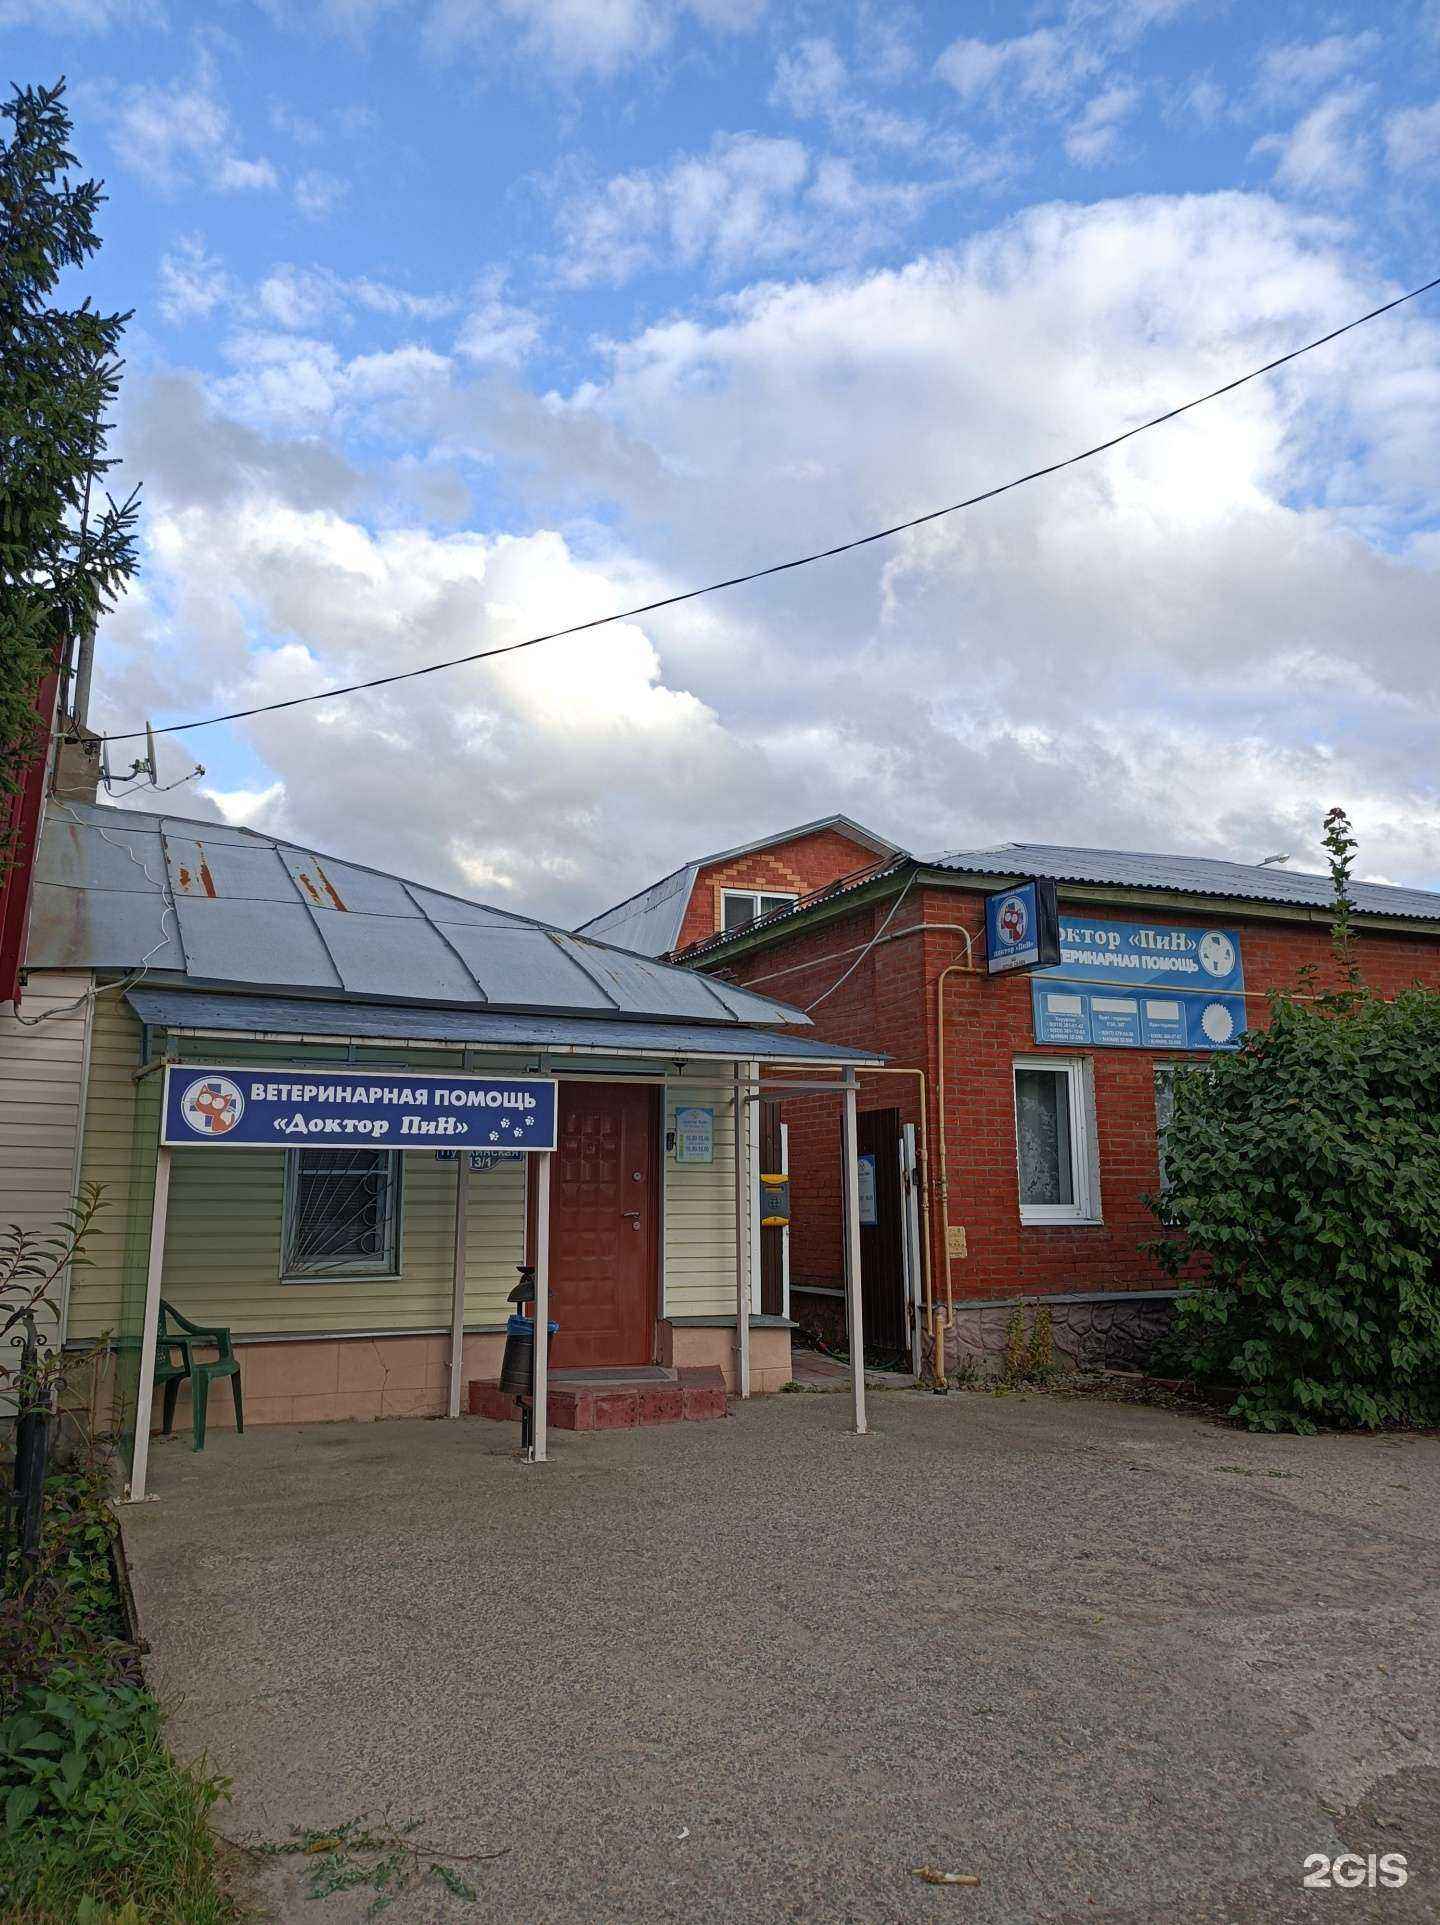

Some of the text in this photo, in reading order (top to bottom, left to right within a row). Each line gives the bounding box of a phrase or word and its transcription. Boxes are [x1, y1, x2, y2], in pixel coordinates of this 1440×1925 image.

[1059, 928, 1197, 951] октор «ПиН»
[1060, 949, 1200, 974] ЕРИНАРНАЯ ПОМОЩЬ
[250, 1083, 537, 1111] ВЕТЕРИНАРНАЯ ПОМОЩЬ
[273, 1113, 470, 1138] «Доктор ПиН»
